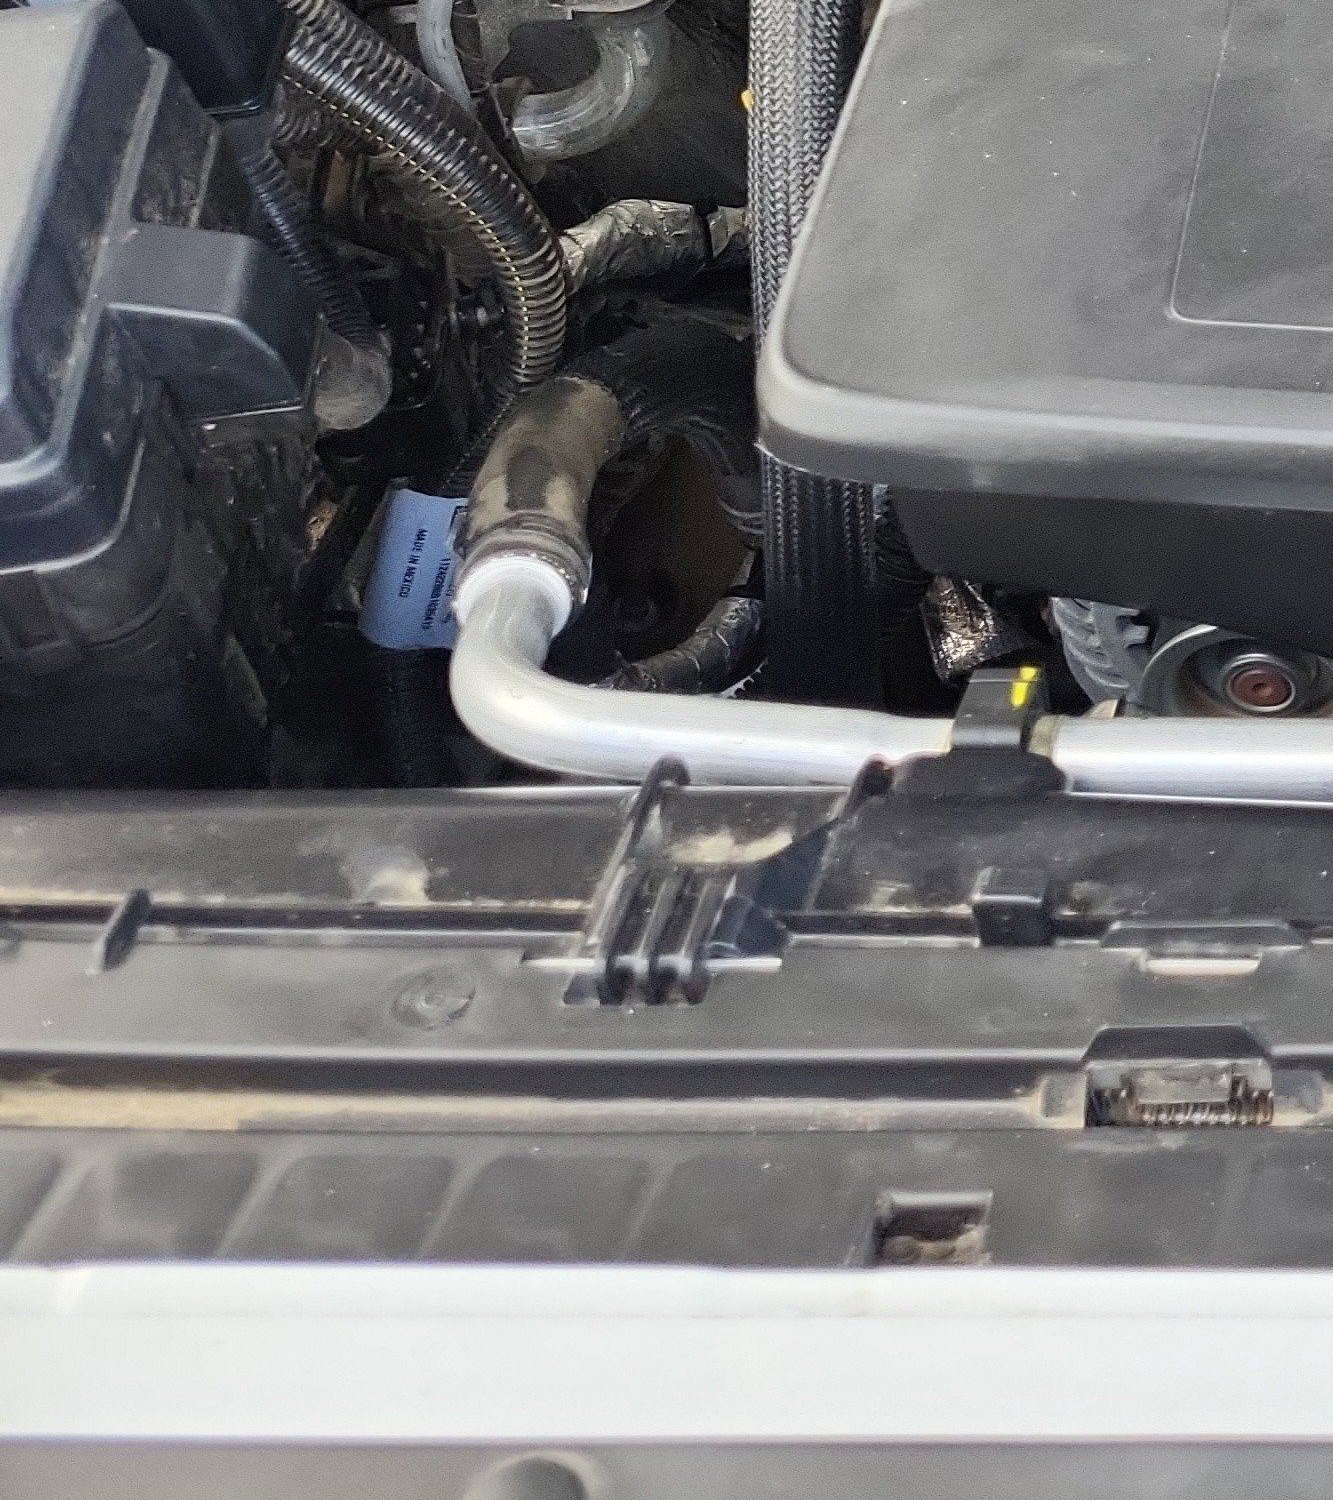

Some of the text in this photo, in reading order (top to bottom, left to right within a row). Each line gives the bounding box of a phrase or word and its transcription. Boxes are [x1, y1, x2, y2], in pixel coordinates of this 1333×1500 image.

[399, 528, 428, 598] MADE IN MEXICO
